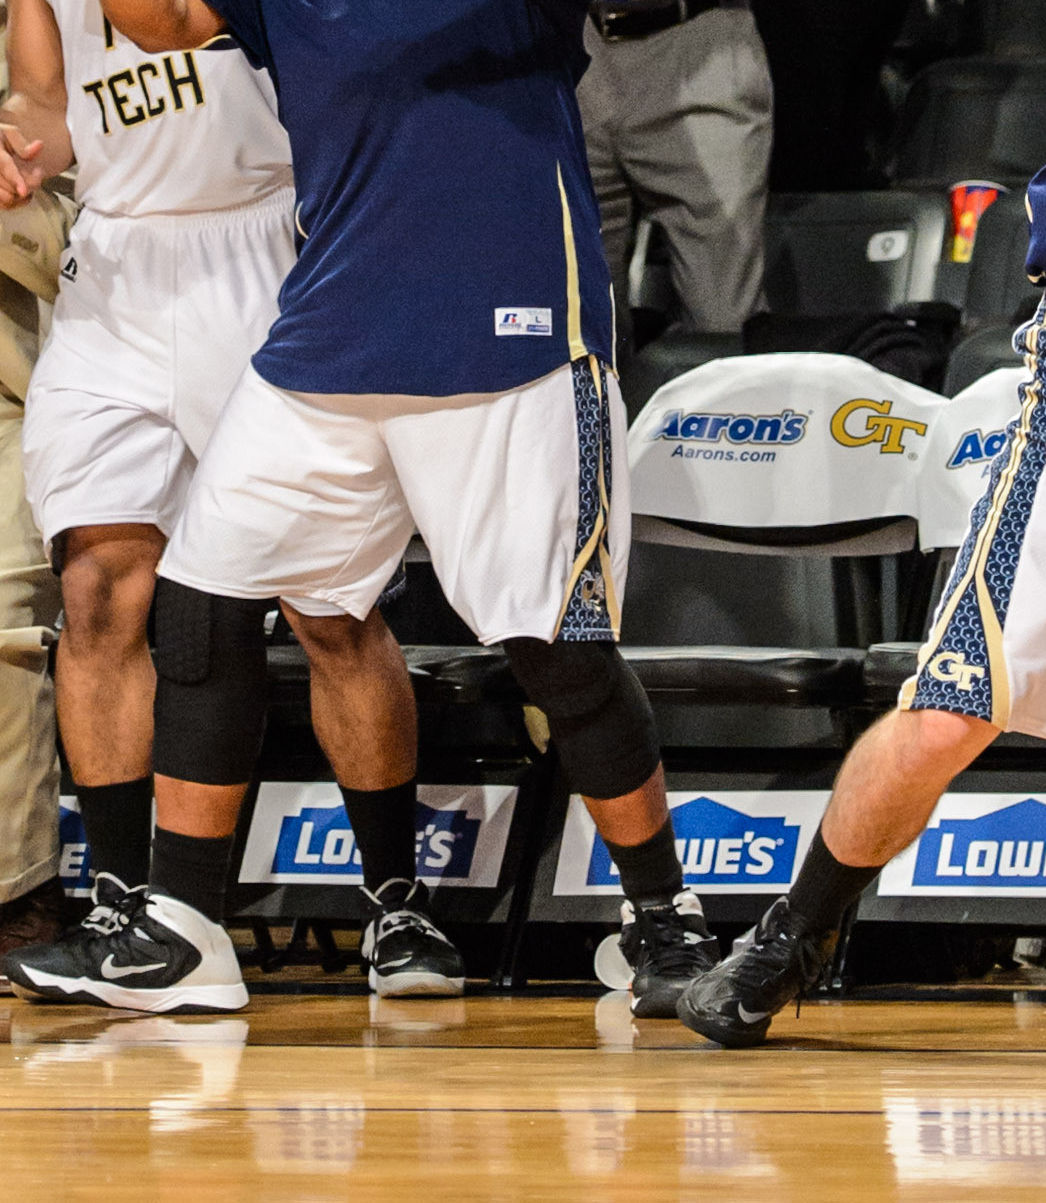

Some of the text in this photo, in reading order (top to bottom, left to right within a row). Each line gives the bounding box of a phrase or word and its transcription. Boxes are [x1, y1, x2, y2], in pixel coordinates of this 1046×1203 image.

[82, 49, 206, 135] TECH
[654, 409, 809, 445] Aaron's
[830, 398, 928, 454] GT
[671, 444, 777, 462] Aarons.com
[928, 651, 985, 691] GT
[294, 823, 455, 868] LO'S
[610, 831, 777, 875] WE'S
